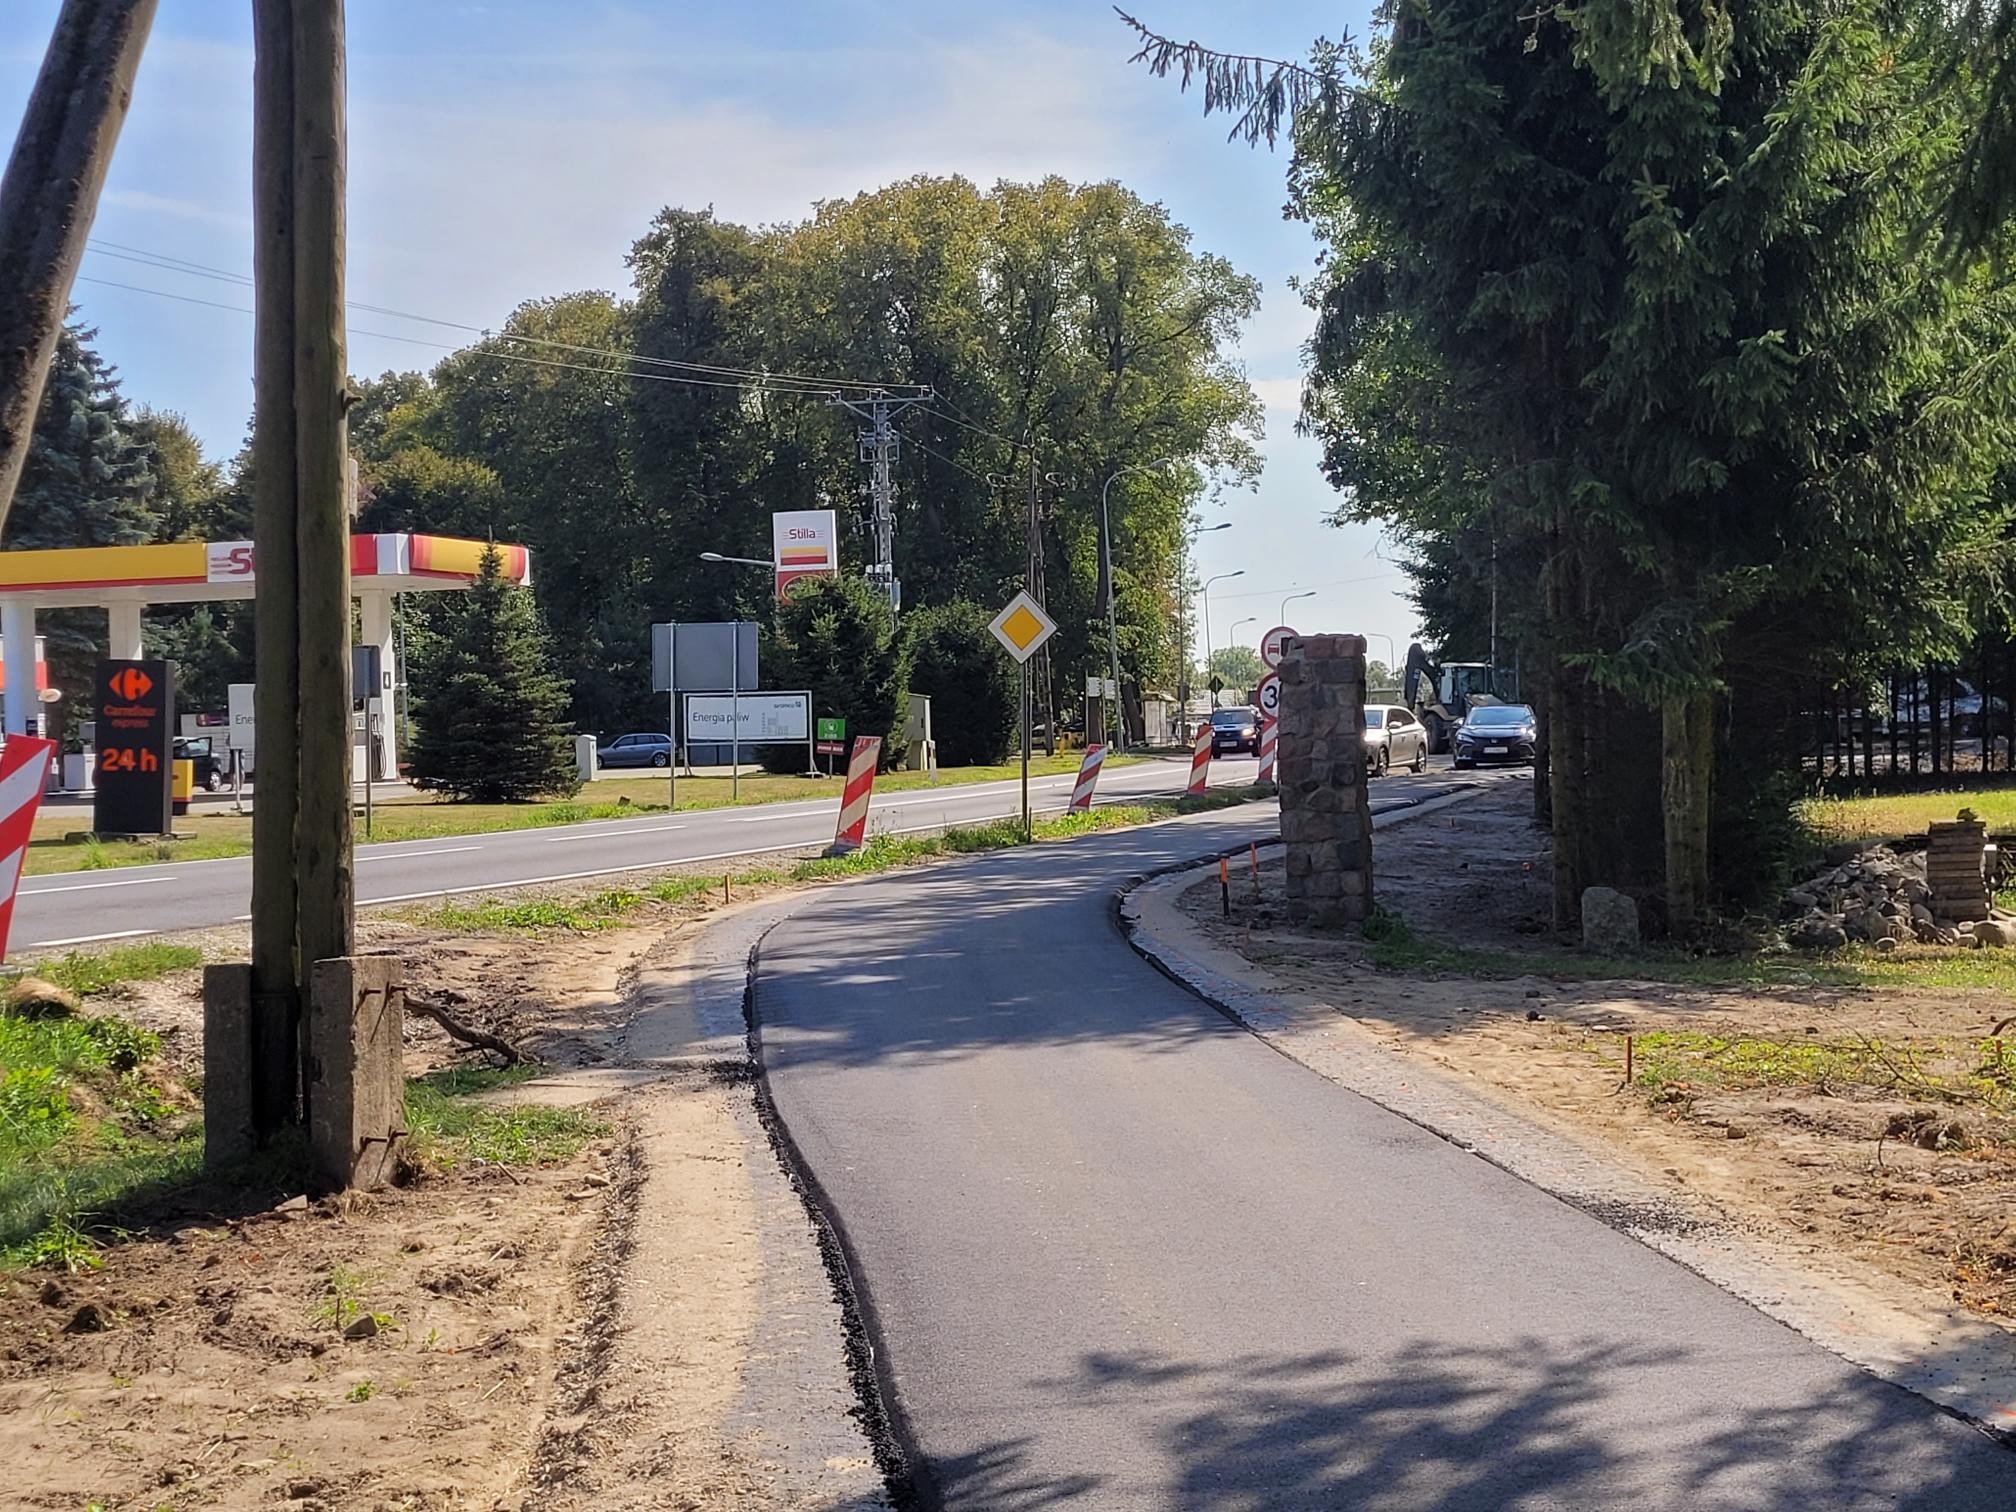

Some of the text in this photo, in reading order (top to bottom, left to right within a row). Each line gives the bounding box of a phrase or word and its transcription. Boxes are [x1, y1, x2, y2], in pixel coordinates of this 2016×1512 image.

[789, 528, 816, 540] Stilla
[692, 712, 725, 725] Energia
[101, 747, 158, 772] 24 h
